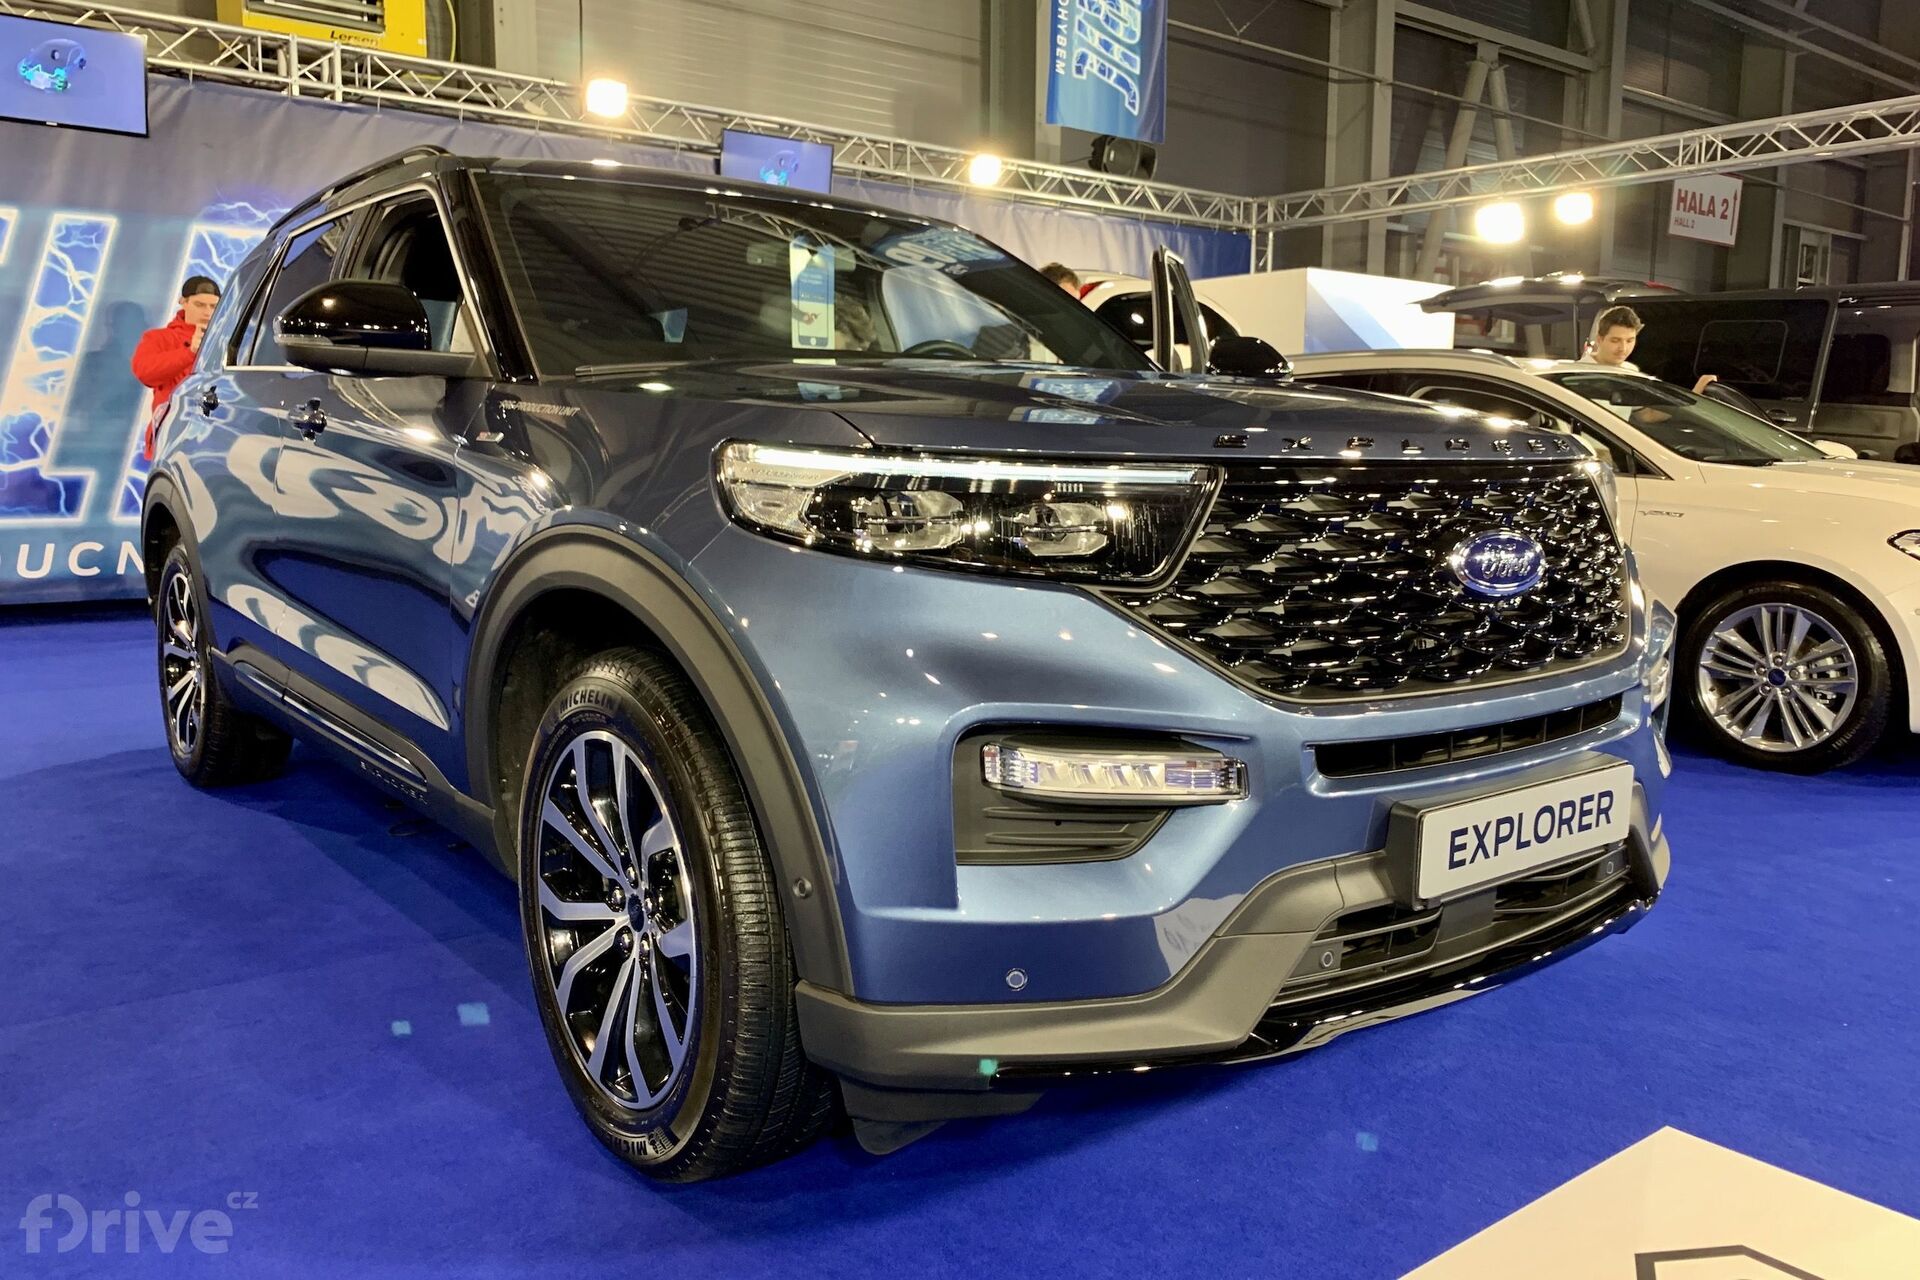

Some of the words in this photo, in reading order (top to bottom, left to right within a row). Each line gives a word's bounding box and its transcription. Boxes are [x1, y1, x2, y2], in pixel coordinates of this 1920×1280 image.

[1676, 188, 1716, 218] HALA
[1720, 198, 1729, 220] 2
[1674, 216, 1690, 228] HALL
[1690, 219, 1695, 229] 2
[0, 541, 145, 579] UCN
[1474, 543, 1536, 579] Ford
[560, 689, 616, 714] MICHELIN
[1448, 790, 1614, 870] EXPLORER
